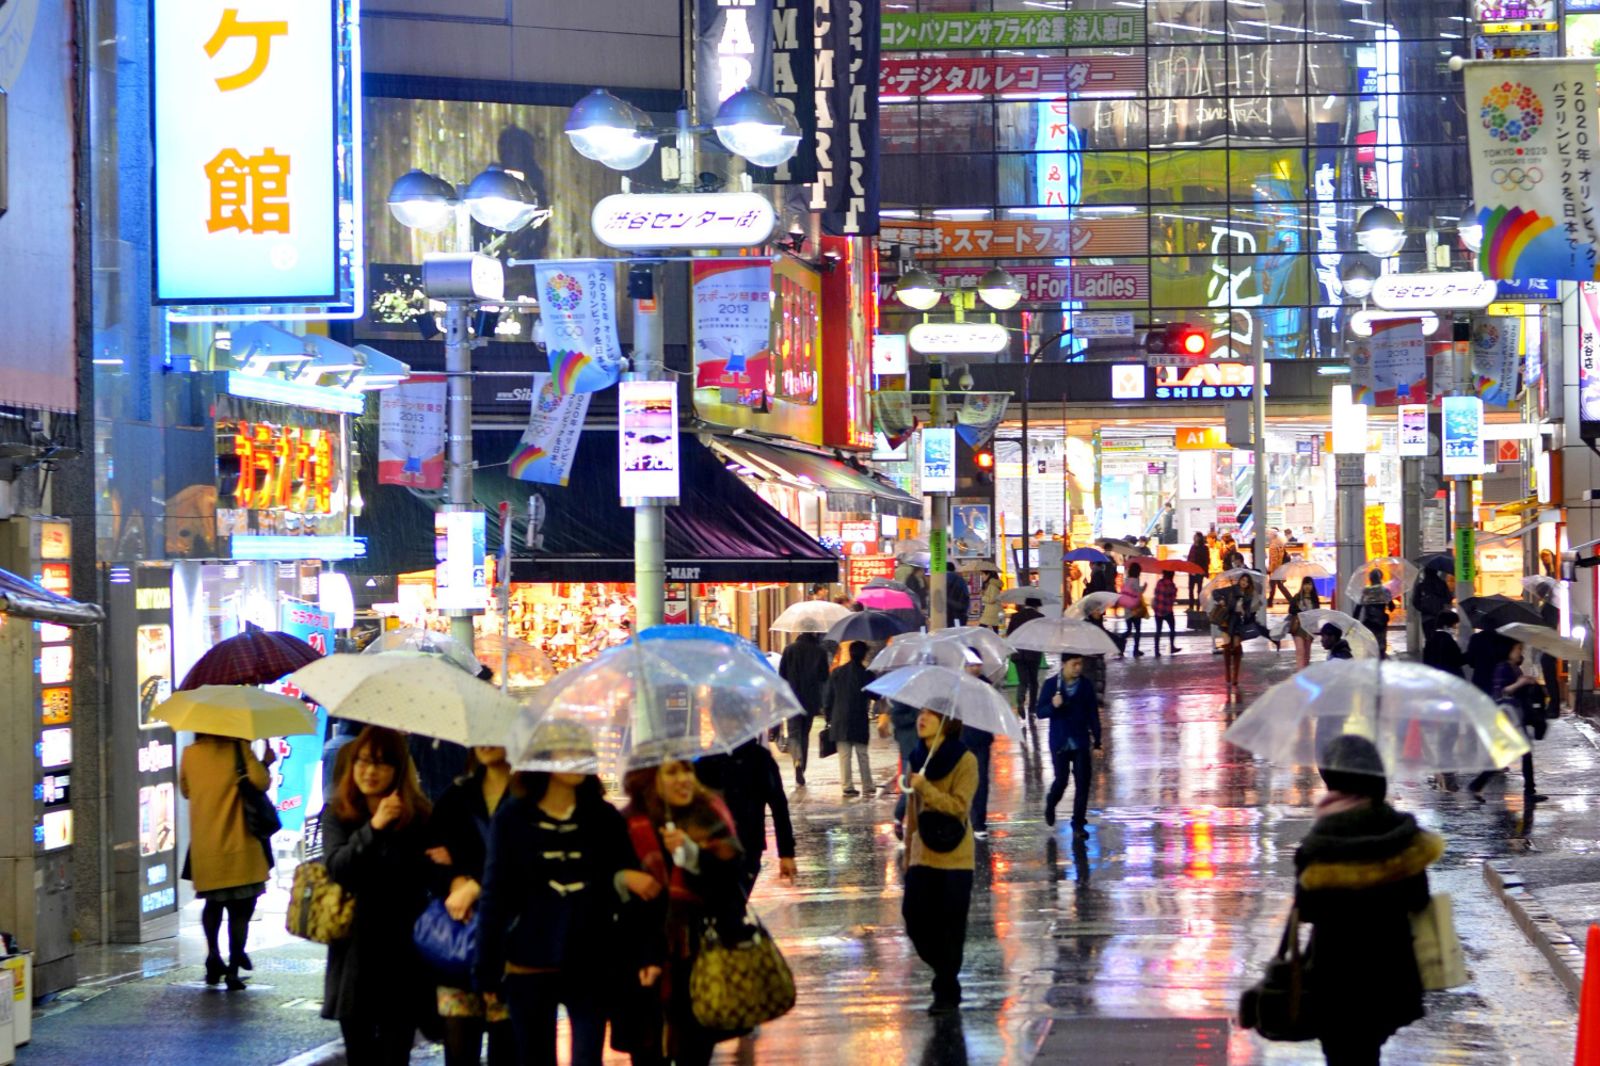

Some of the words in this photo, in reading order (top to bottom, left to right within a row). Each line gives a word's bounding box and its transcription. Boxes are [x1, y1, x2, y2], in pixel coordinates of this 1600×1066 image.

[203, 8, 291, 235] ケ館
[1073, 272, 1135, 297] Ladies
[718, 304, 749, 314] 2013
[1186, 432, 1205, 445] A1
[664, 566, 700, 580] -MART
